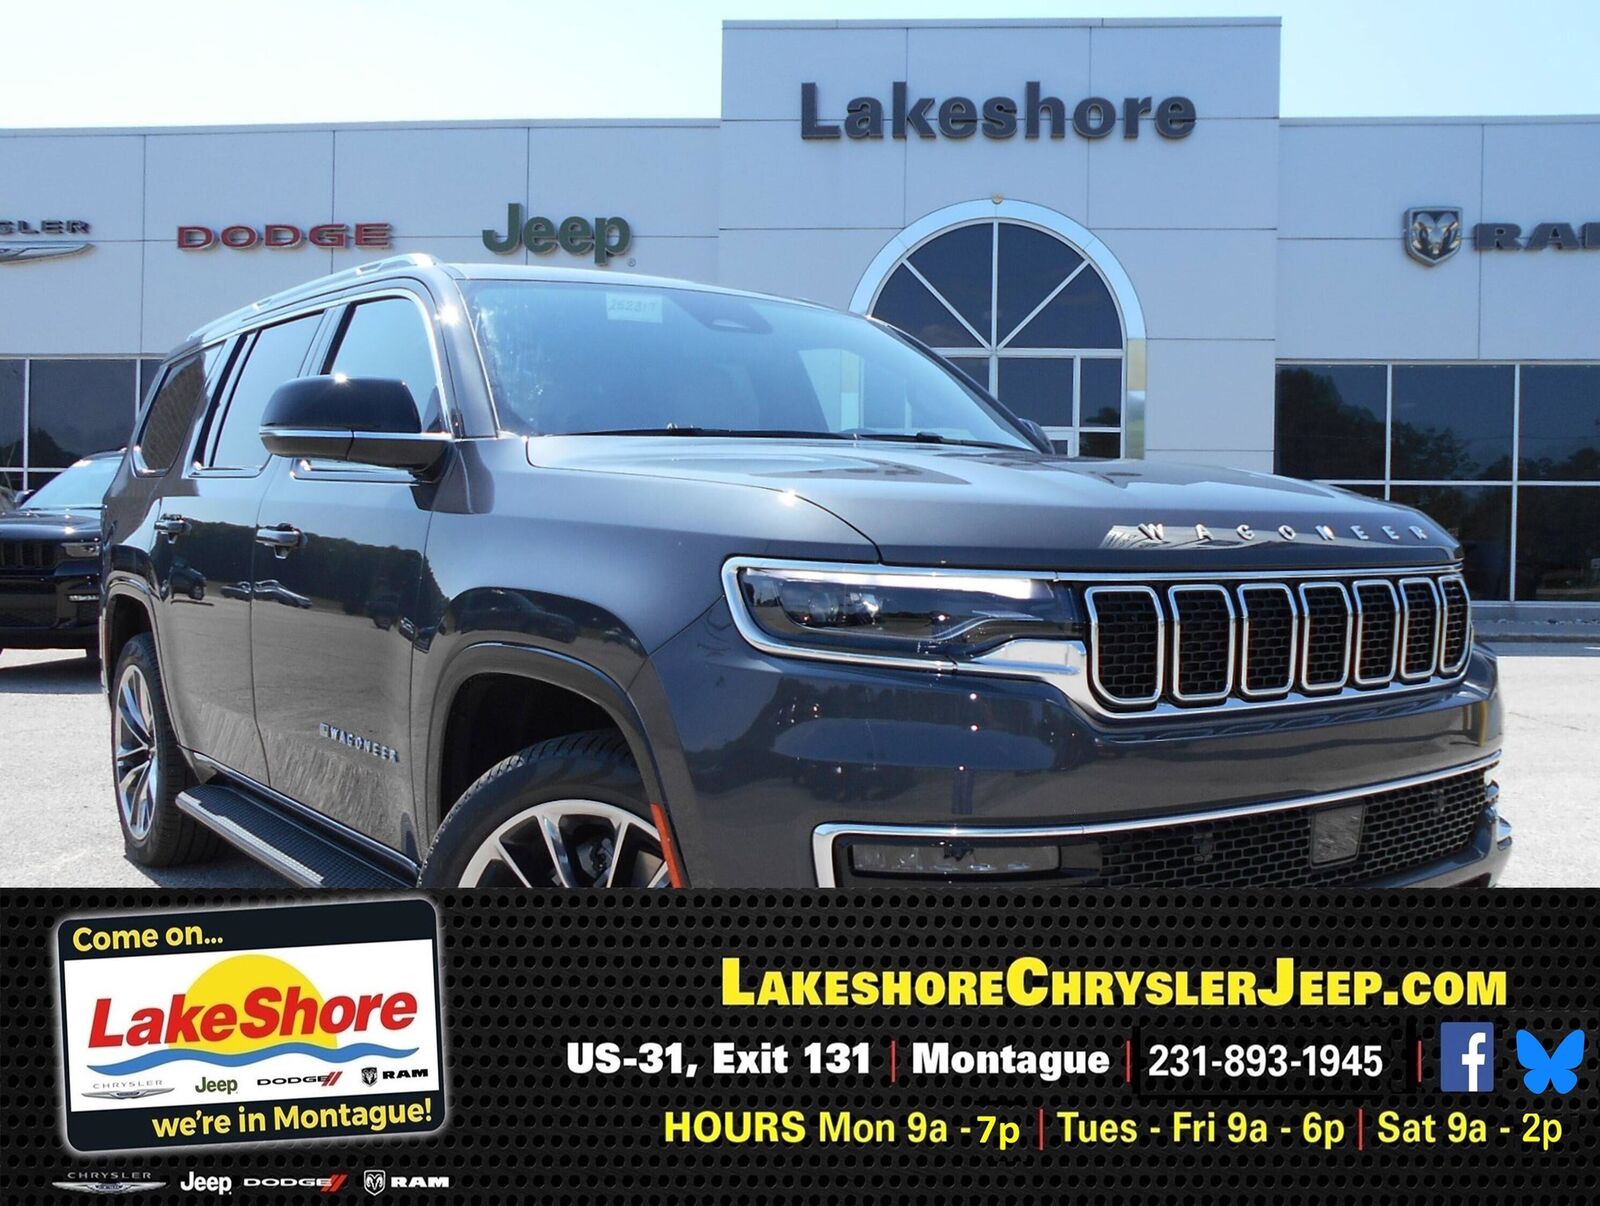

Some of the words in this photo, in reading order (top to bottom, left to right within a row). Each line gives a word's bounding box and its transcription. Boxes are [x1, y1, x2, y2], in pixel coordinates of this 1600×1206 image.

[801, 81, 1197, 140] Lakeshore
[176, 223, 393, 250] DODGE
[482, 203, 632, 266] Jeep
[1137, 522, 1429, 541] WAGONEER
[329, 725, 399, 763] WAGONEER
